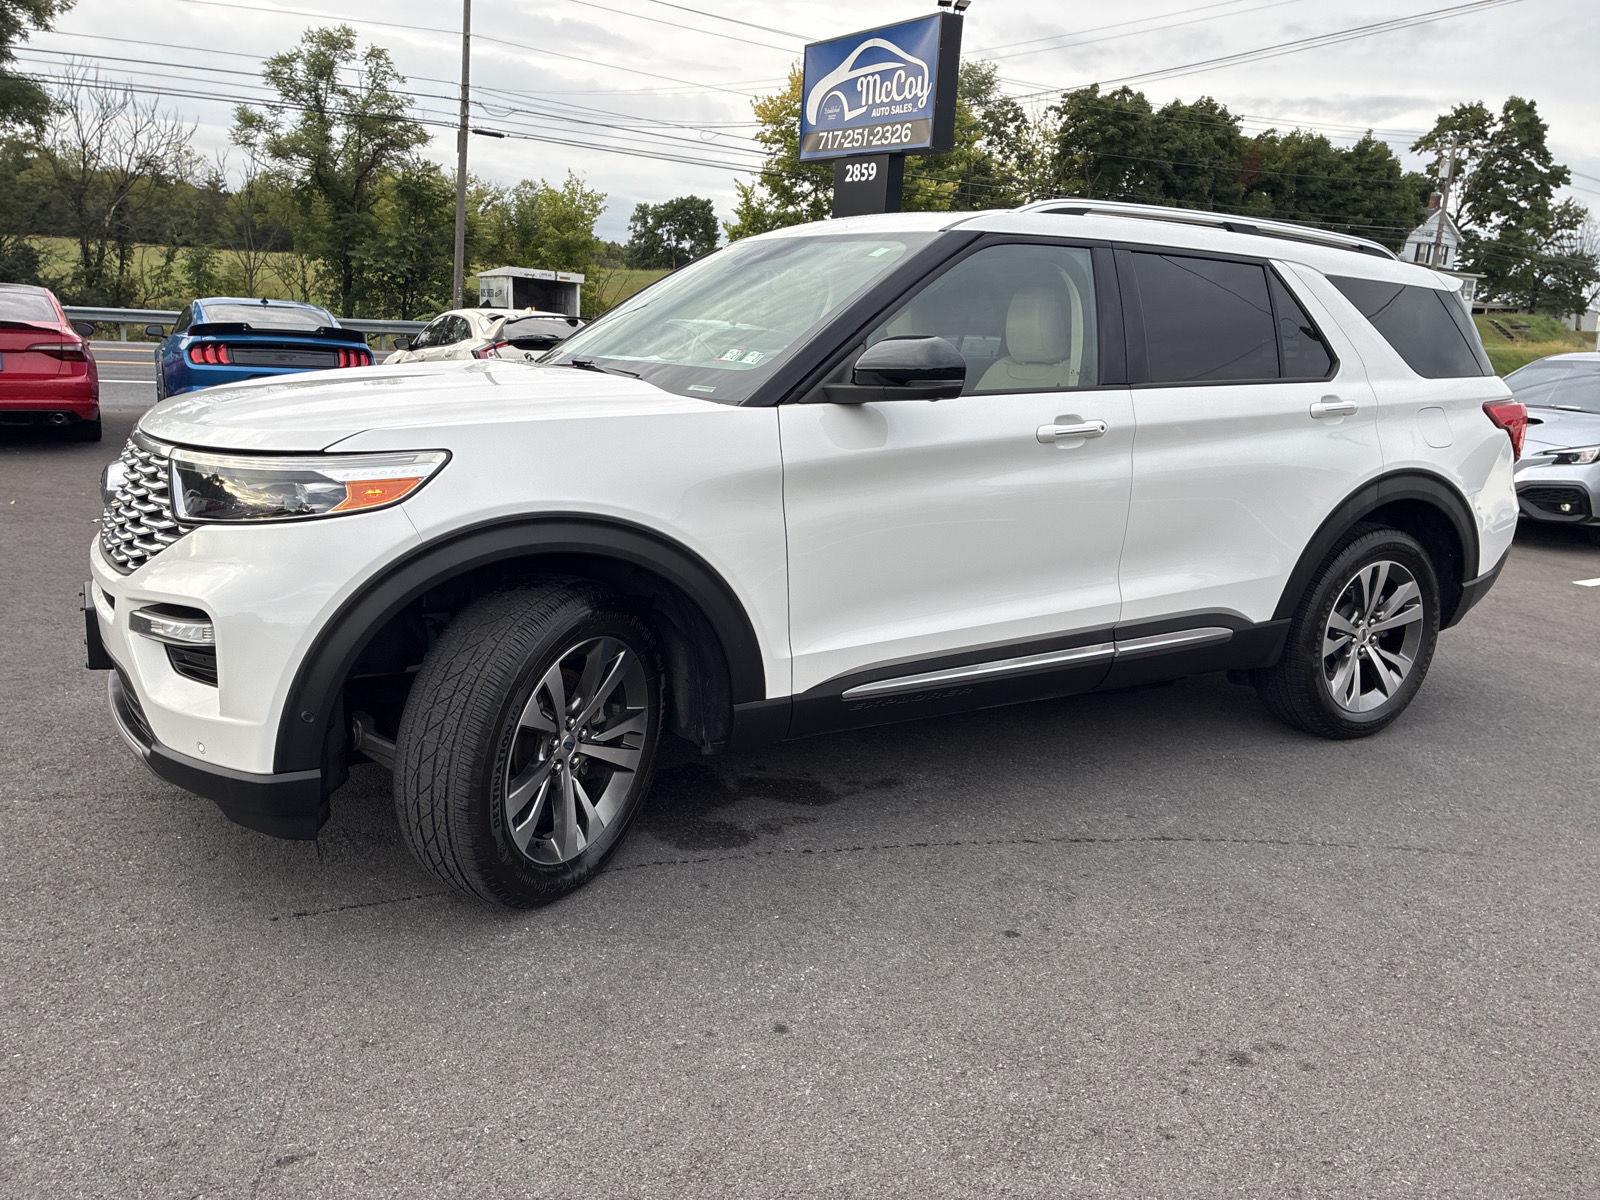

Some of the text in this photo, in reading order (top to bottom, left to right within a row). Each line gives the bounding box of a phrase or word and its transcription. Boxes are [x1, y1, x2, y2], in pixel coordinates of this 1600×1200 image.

[857, 69, 932, 108] McCoy
[871, 106, 890, 118] AUTO
[890, 103, 913, 116] SALES
[818, 123, 912, 149] 717-251-2326
[844, 162, 877, 183] 2859
[492, 724, 514, 829] DESTINATION
